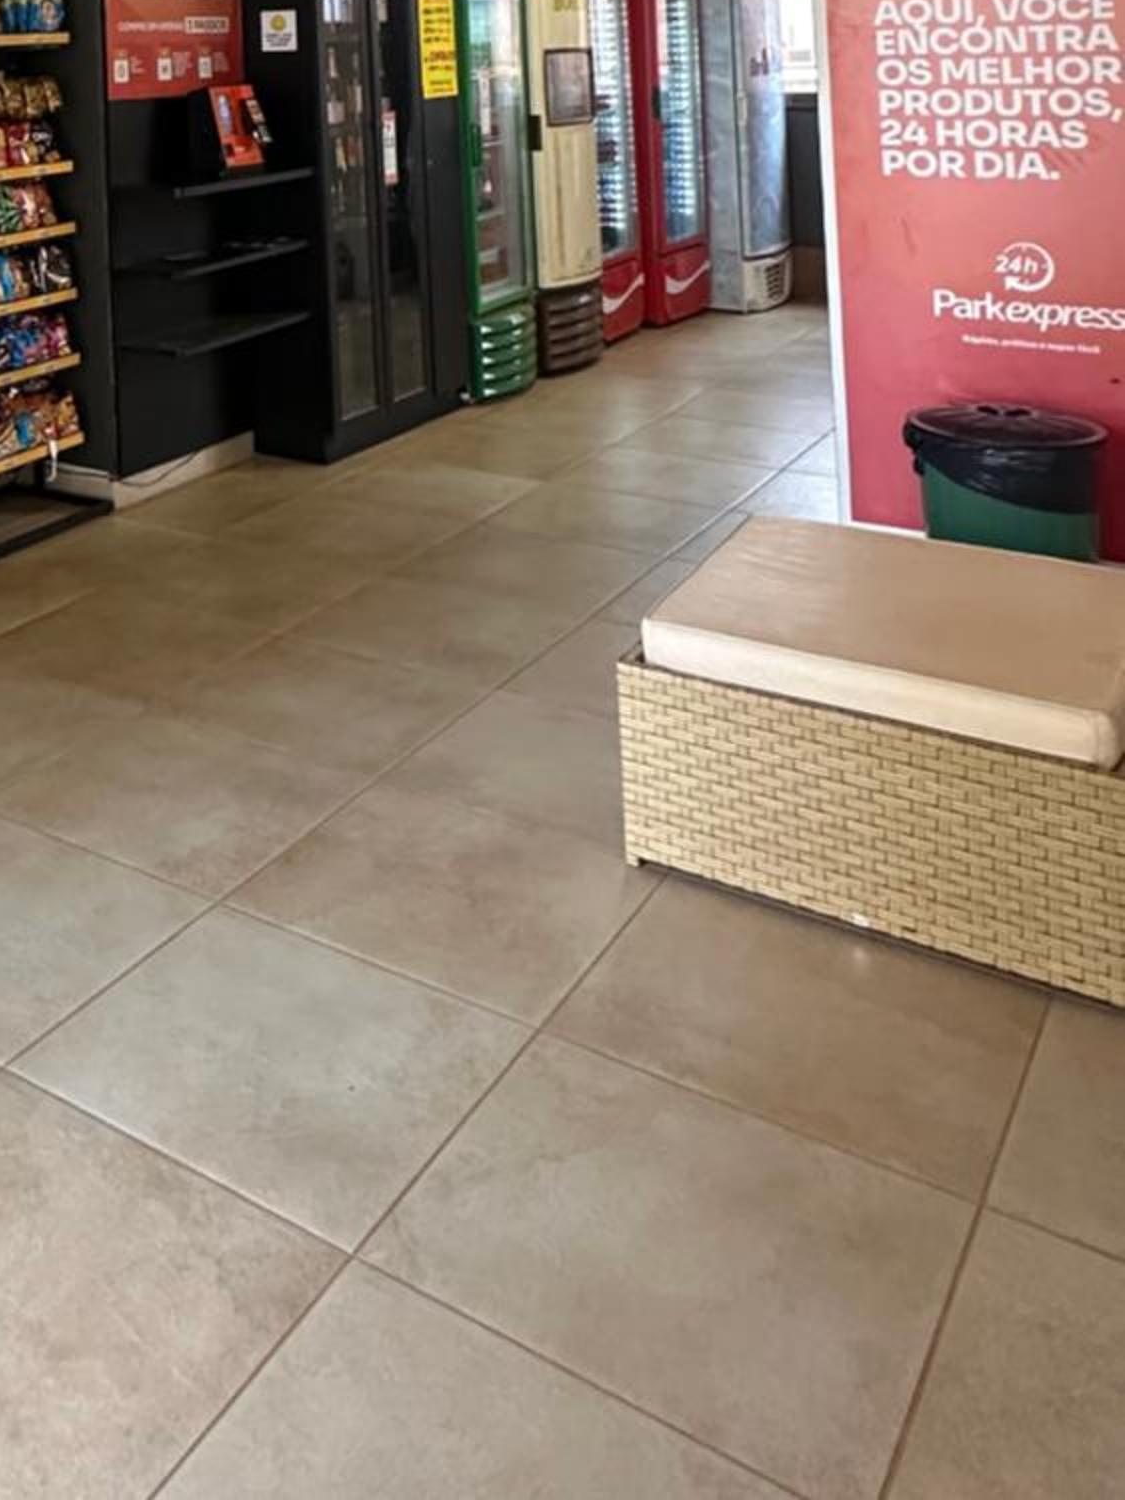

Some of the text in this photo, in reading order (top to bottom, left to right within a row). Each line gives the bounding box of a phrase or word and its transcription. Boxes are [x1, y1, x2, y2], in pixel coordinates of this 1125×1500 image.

[875, 22, 1120, 56] ENCONTRA
[876, 55, 1123, 86] OS MELHOR
[878, 87, 1123, 123] PRODUTOS,
[879, 118, 1090, 149] 24 HORAS
[881, 148, 1061, 180] POR DIA.
[994, 254, 1039, 274] 24h
[932, 288, 1125, 333] Parkexpress
